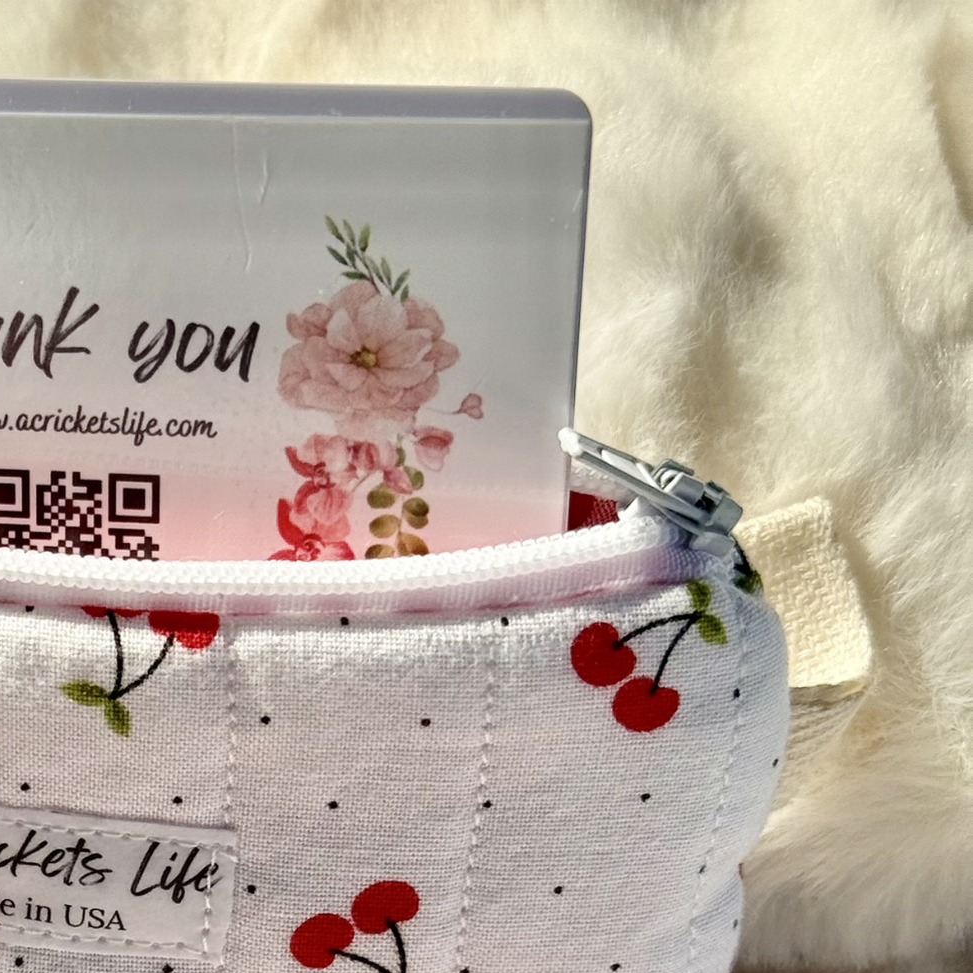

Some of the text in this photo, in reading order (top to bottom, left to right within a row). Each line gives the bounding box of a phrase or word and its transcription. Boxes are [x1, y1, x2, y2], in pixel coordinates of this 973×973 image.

[127, 318, 261, 383] you
[130, 841, 224, 904] Life
[26, 897, 53, 924] in
[64, 904, 127, 932] USA
